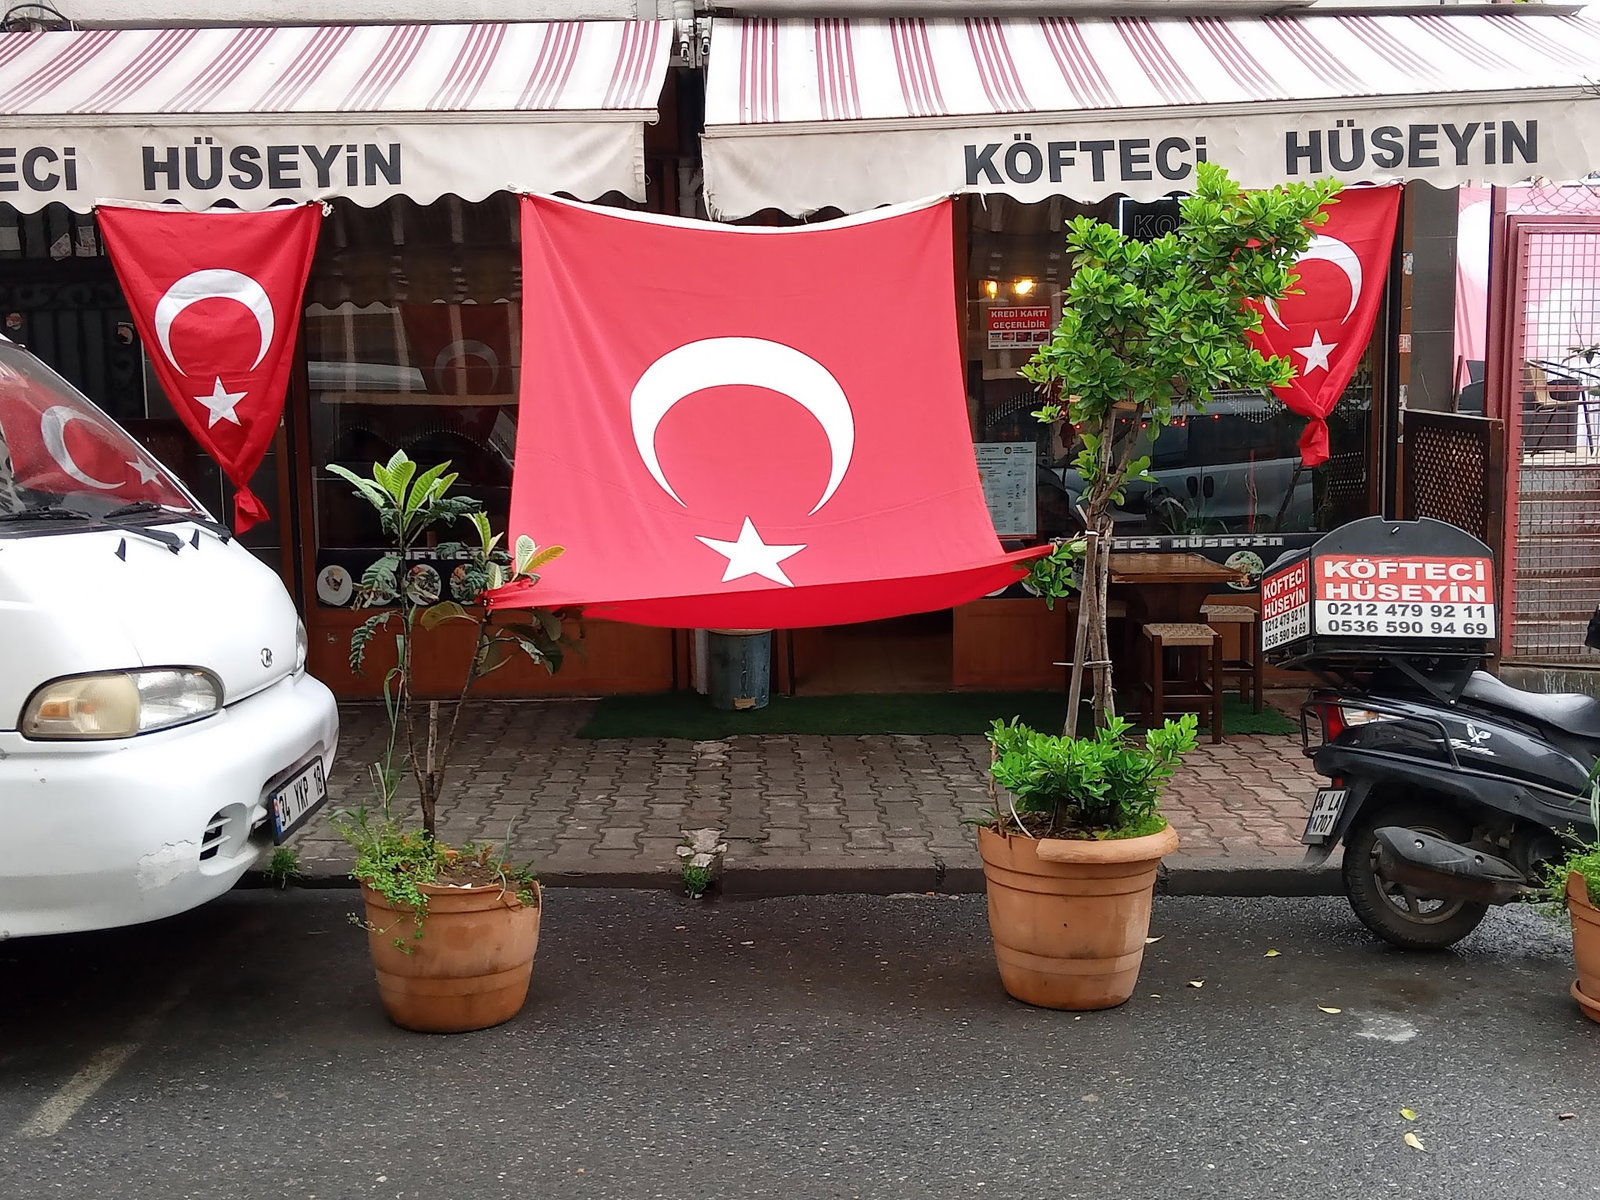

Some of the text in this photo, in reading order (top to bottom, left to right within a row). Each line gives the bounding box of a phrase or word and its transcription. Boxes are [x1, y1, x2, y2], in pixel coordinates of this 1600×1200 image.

[991, 309, 1047, 318] KREDİ KARTI
[993, 320, 1046, 329] GEÇERLİDİR
[1324, 558, 1485, 581] KÖFTECİ
[1263, 563, 1306, 601] KÖFTECİ
[1325, 580, 1486, 603] HÜSEYİN
[1264, 587, 1306, 619] HÜSEYİN
[1327, 602, 1486, 619] 0212 479 92 11
[1264, 618, 1279, 633] 0212
[1291, 610, 1298, 623] 92
[1299, 605, 1306, 618] 11
[1328, 619, 1488, 635] 0536 590 94 69
[1264, 621, 1306, 648] 0536 590 94 69
[279, 792, 292, 827] 34
[293, 776, 309, 813] YKP
[1328, 793, 1343, 811] LA
